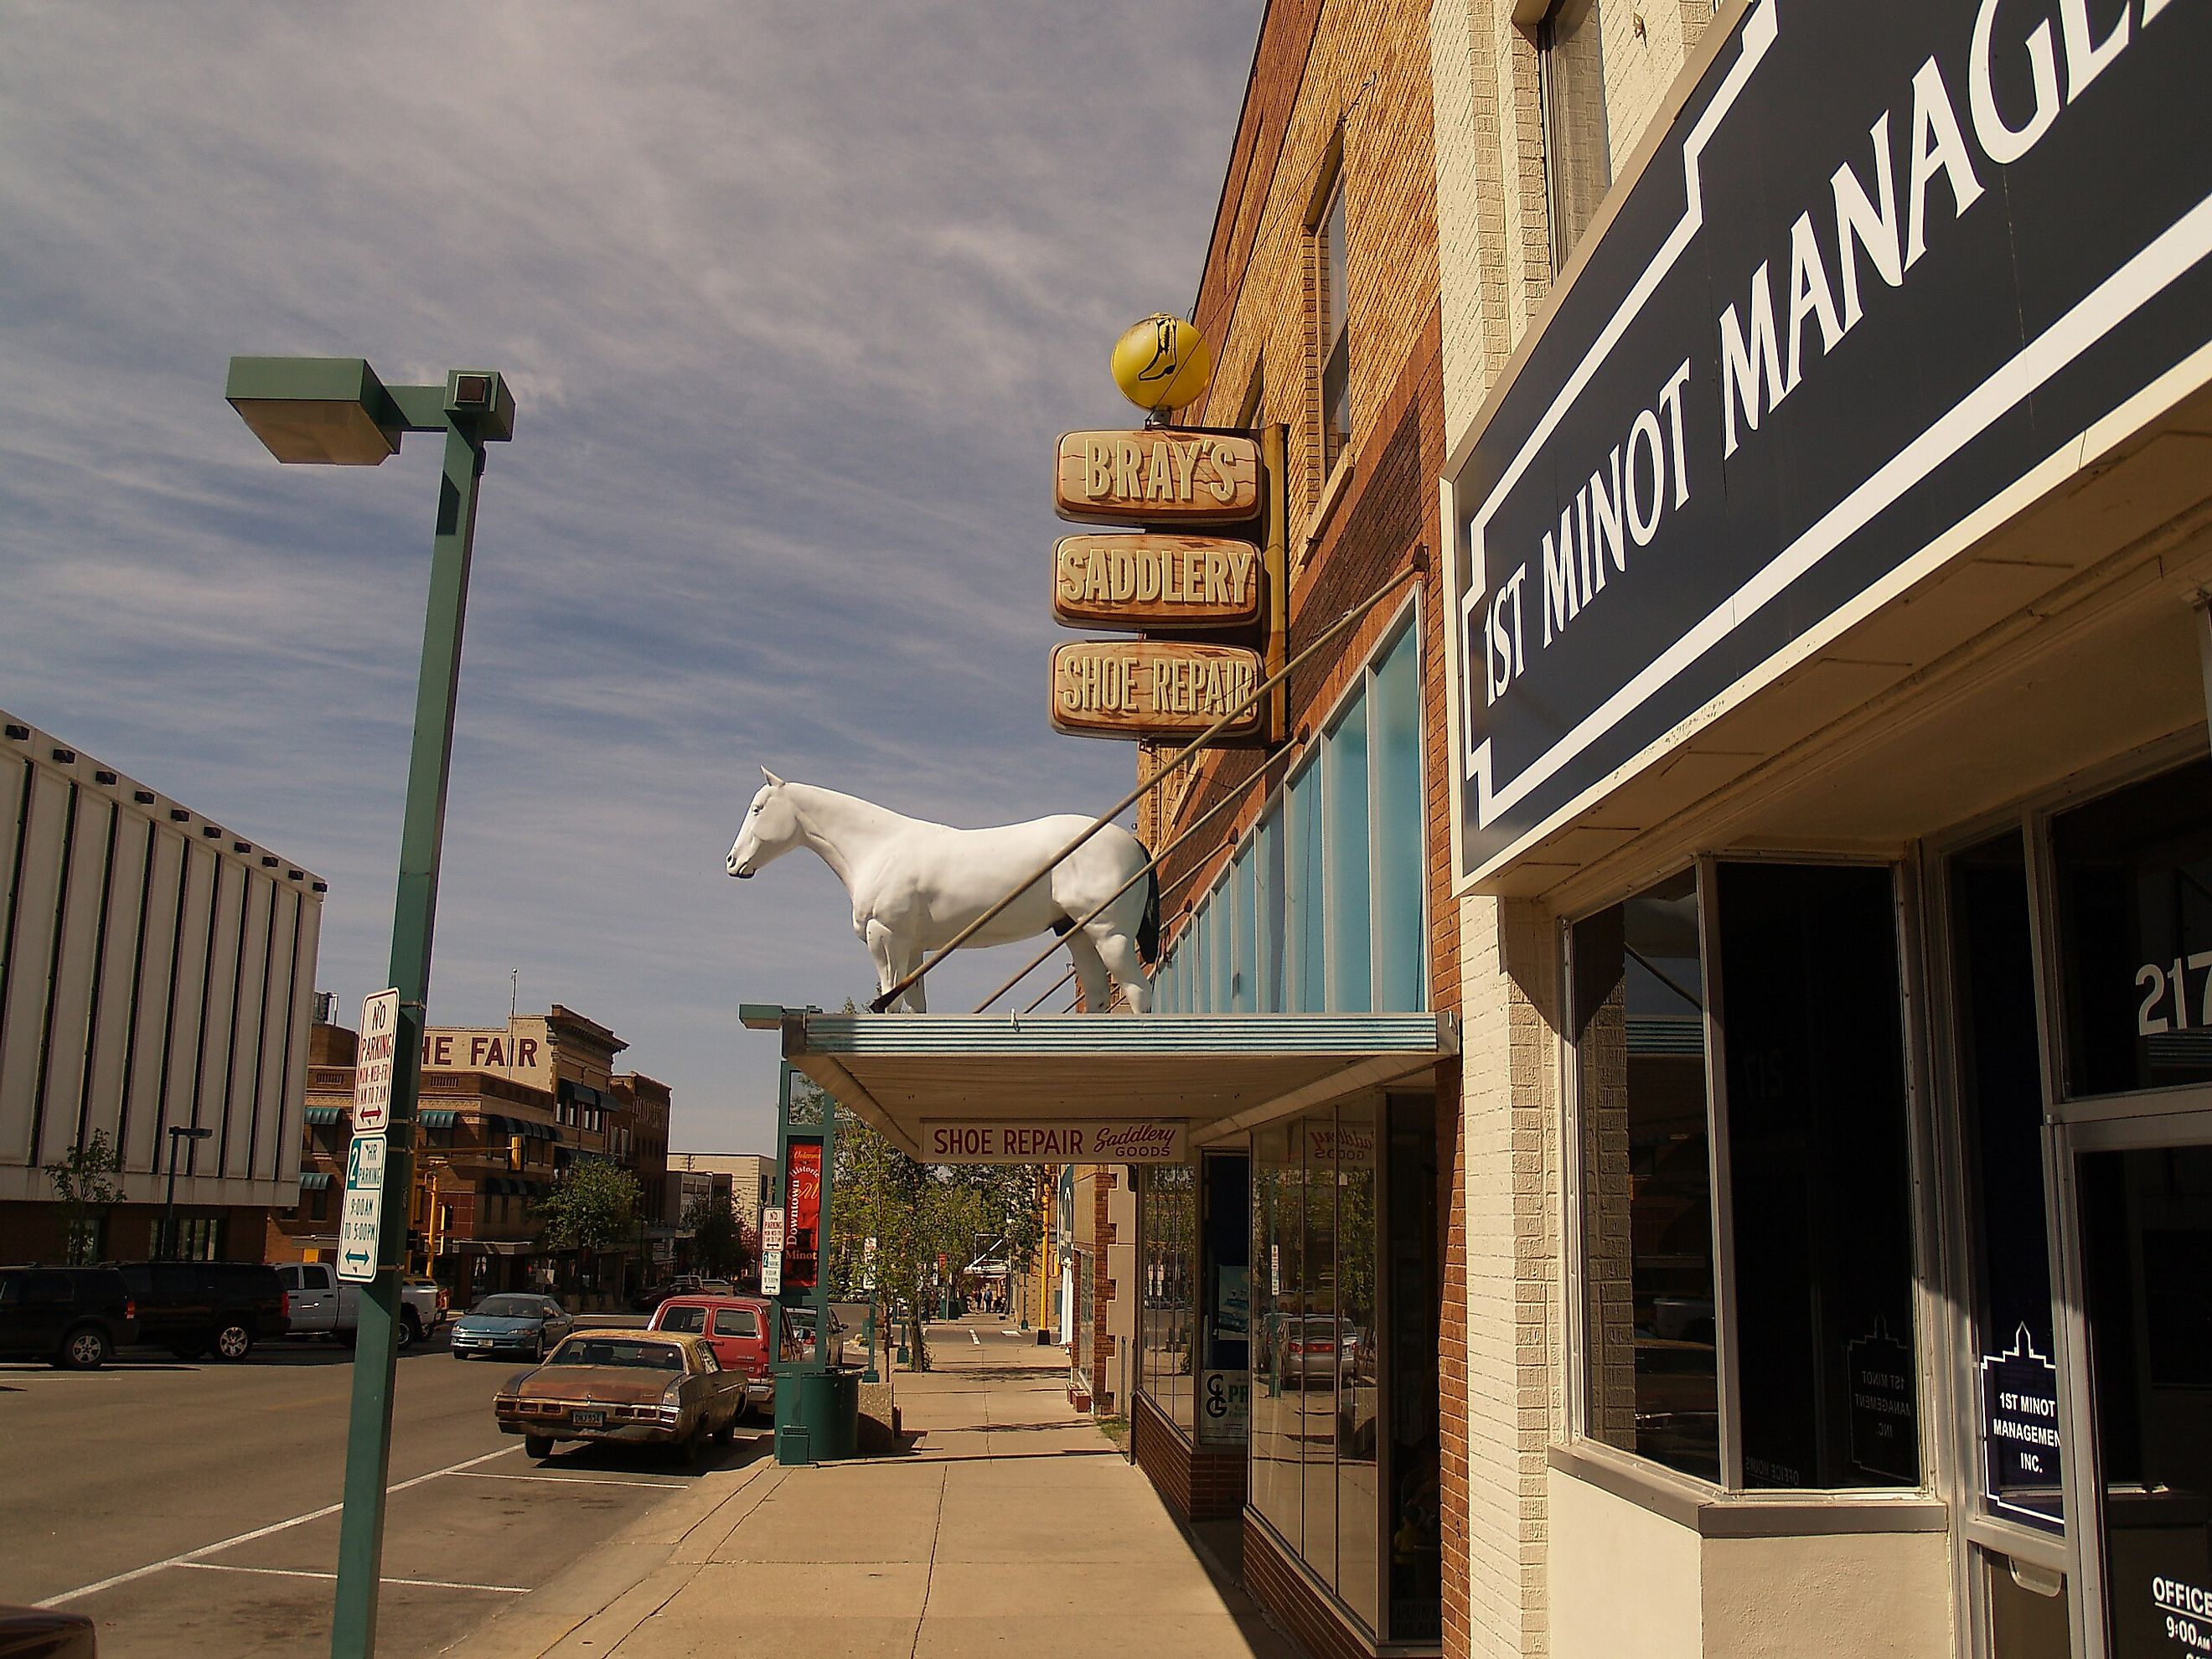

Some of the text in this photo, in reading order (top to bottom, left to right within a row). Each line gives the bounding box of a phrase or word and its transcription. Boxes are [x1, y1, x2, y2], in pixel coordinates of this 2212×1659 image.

[1484, 0, 2173, 708] 1ST MINOT MANAG
[1085, 438, 1238, 505] BRAY'S
[1060, 549, 1253, 605] SADDLERY
[1063, 655, 1254, 716] SHOE REPAIR
[2135, 949, 2212, 1036] 217
[371, 1004, 386, 1031] NO
[360, 1032, 392, 1062] PARKING
[470, 1037, 538, 1067] FAIR
[933, 1129, 1083, 1155] SHOE REPAIR
[1093, 1124, 1176, 1154] Saddlery
[1115, 1146, 1171, 1158] GOODS
[349, 1145, 378, 1181] 2 HR
[358, 1166, 381, 1186] PARKING
[787, 1180, 799, 1246] Downtown
[344, 1222, 352, 1240] TO
[785, 1250, 817, 1260] Minot
[1999, 1392, 2055, 1418] 1ST MINOT
[2020, 1451, 2043, 1474] INC.
[2153, 1576, 2212, 1618] OFFICE
